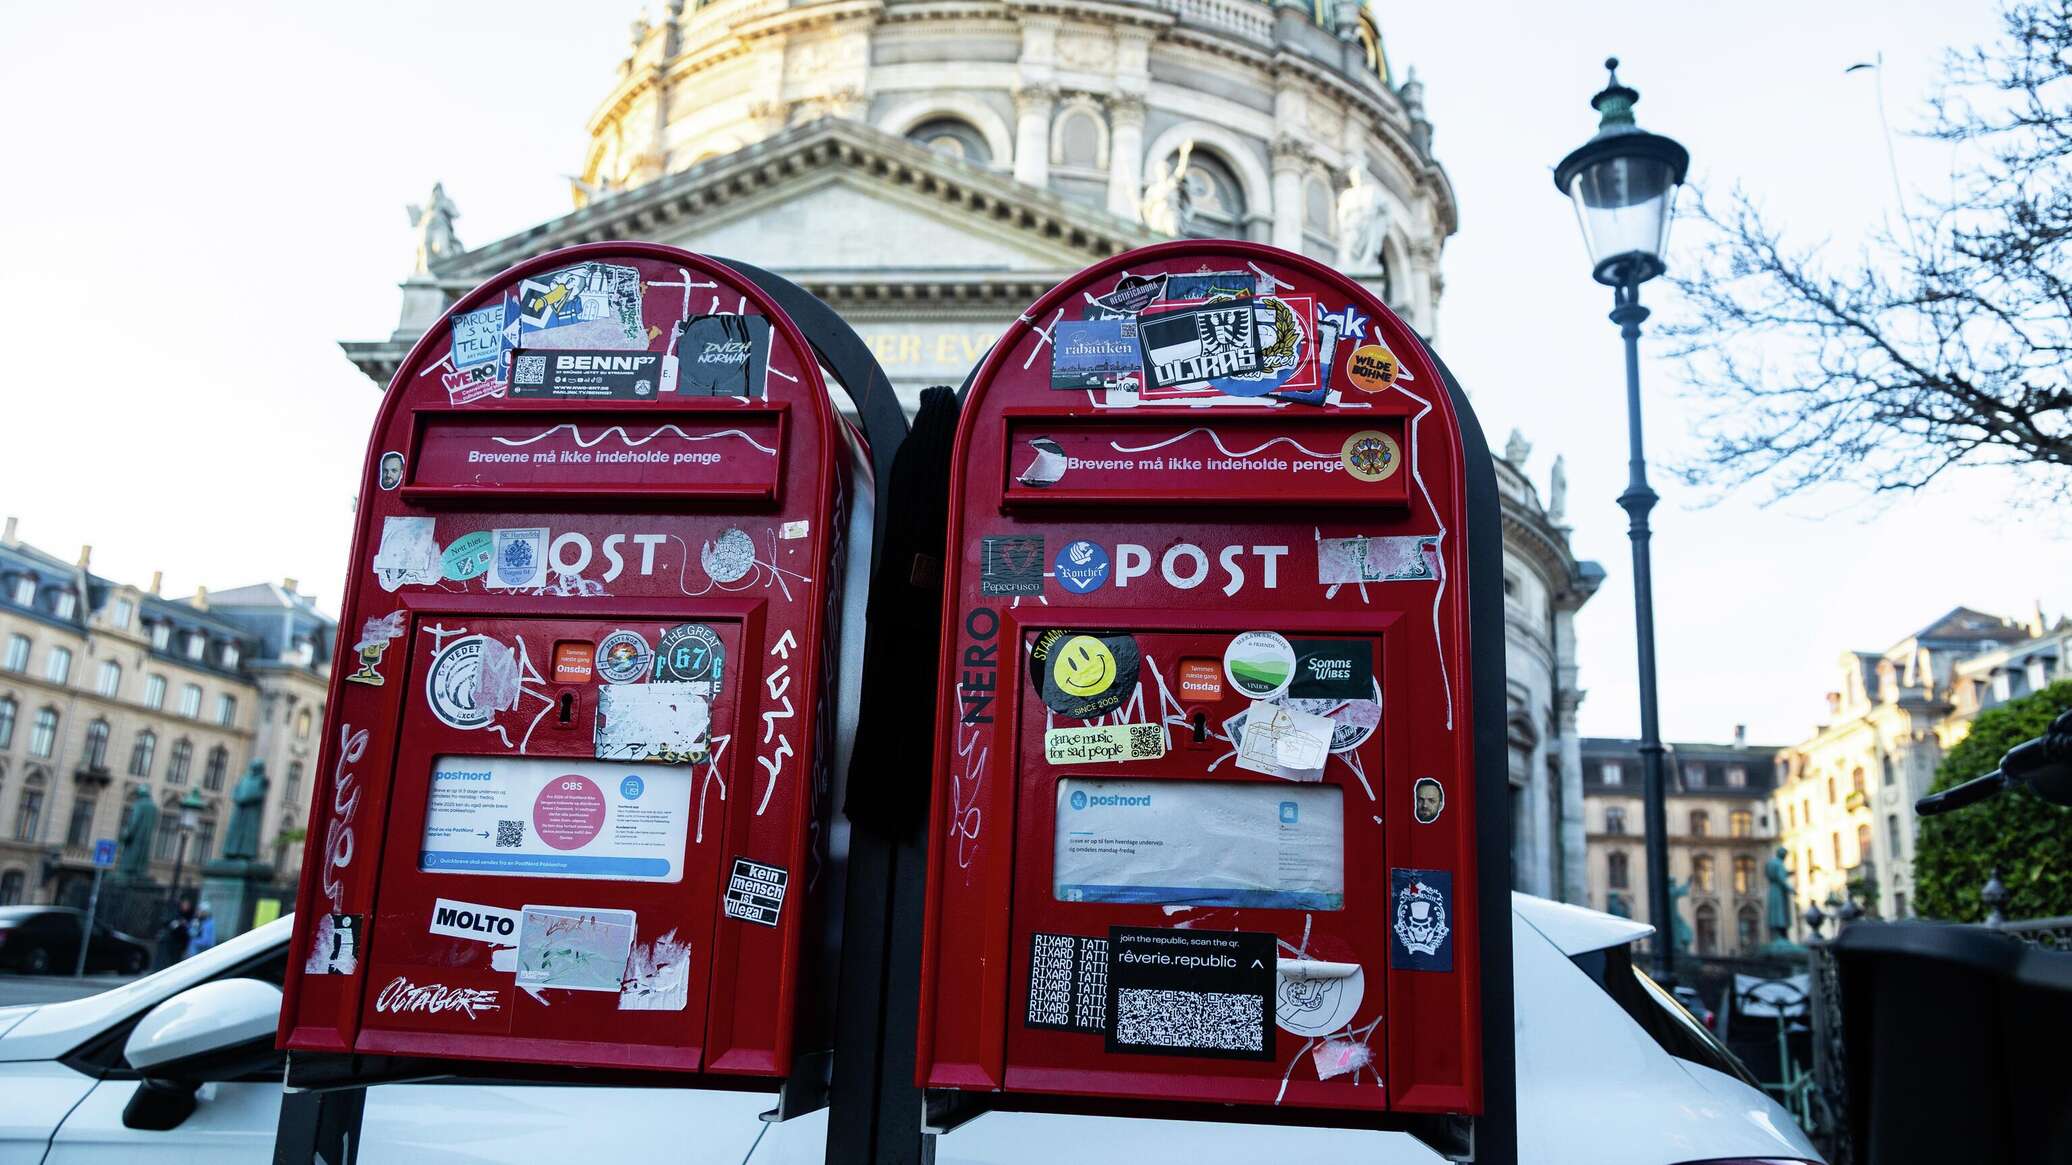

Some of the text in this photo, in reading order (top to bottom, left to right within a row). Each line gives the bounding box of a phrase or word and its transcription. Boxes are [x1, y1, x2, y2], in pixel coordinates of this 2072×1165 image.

[1125, 280, 1136, 289] LA
[1109, 281, 1159, 305] RECTIFICADORA
[453, 307, 503, 329] PAROLE
[457, 335, 498, 353] TELA
[698, 352, 751, 365] NORWAY
[1154, 347, 1256, 383] ULTRAS
[1356, 355, 1391, 371] WILDE
[468, 449, 721, 465] Brevene må ikke indeholde penge
[1068, 455, 1345, 474] Brevene må ikke indeholde penge
[450, 544, 467, 556] Nett
[549, 531, 667, 583] OST
[1116, 543, 1289, 597] POST
[663, 625, 721, 648] THE GREAT
[674, 646, 707, 670] 67
[557, 665, 592, 675] Onsdag
[961, 607, 999, 725] NERO
[1203, 673, 1218, 681] gang
[1182, 681, 1221, 693] Onsdag
[1074, 695, 1119, 716] SINCE 2005
[1050, 732, 1113, 747] dance music
[1050, 742, 1124, 760] for sad people
[436, 771, 492, 783] postnord
[562, 782, 583, 791] OBS
[1090, 794, 1151, 808] postnord
[749, 865, 779, 882] kein
[732, 877, 783, 898] mensch
[741, 894, 753, 905] ist
[728, 900, 763, 919] illegal
[436, 909, 515, 935] MOLTO
[1036, 935, 1074, 948] RIXARD
[1120, 934, 1136, 944] join
[1137, 935, 1151, 943] the
[1152, 936, 1190, 946] republic,
[1213, 938, 1227, 947] the
[1229, 940, 1240, 948] qr.
[1035, 946, 1073, 959] RIXARD
[1118, 950, 1237, 969] rêverie.republic
[1034, 957, 1072, 969] RIXARD
[1033, 967, 1071, 980] RIXARD
[1032, 978, 1071, 991] RIXARD
[1031, 989, 1070, 1002] RIXARD
[1030, 1000, 1069, 1013] RIXARD
[1029, 1011, 1068, 1024] RIXARD
